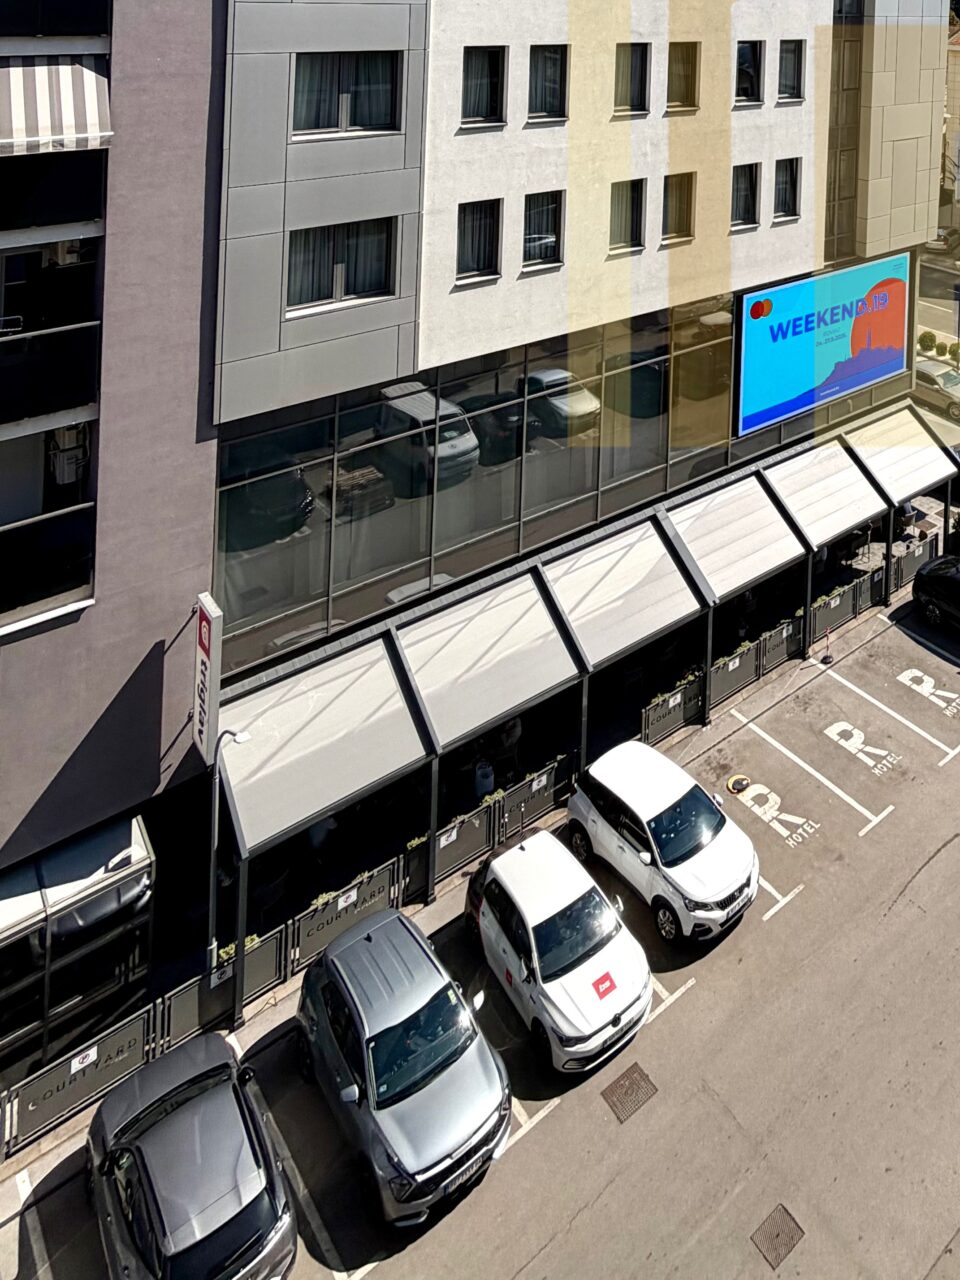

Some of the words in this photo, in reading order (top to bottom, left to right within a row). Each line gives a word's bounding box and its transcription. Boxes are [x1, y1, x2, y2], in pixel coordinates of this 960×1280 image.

[769, 291, 889, 343] WEEKEND.19
[197, 658, 208, 746] triglav
[872, 753, 903, 776] HOTEL
[785, 820, 821, 848] HOTEL
